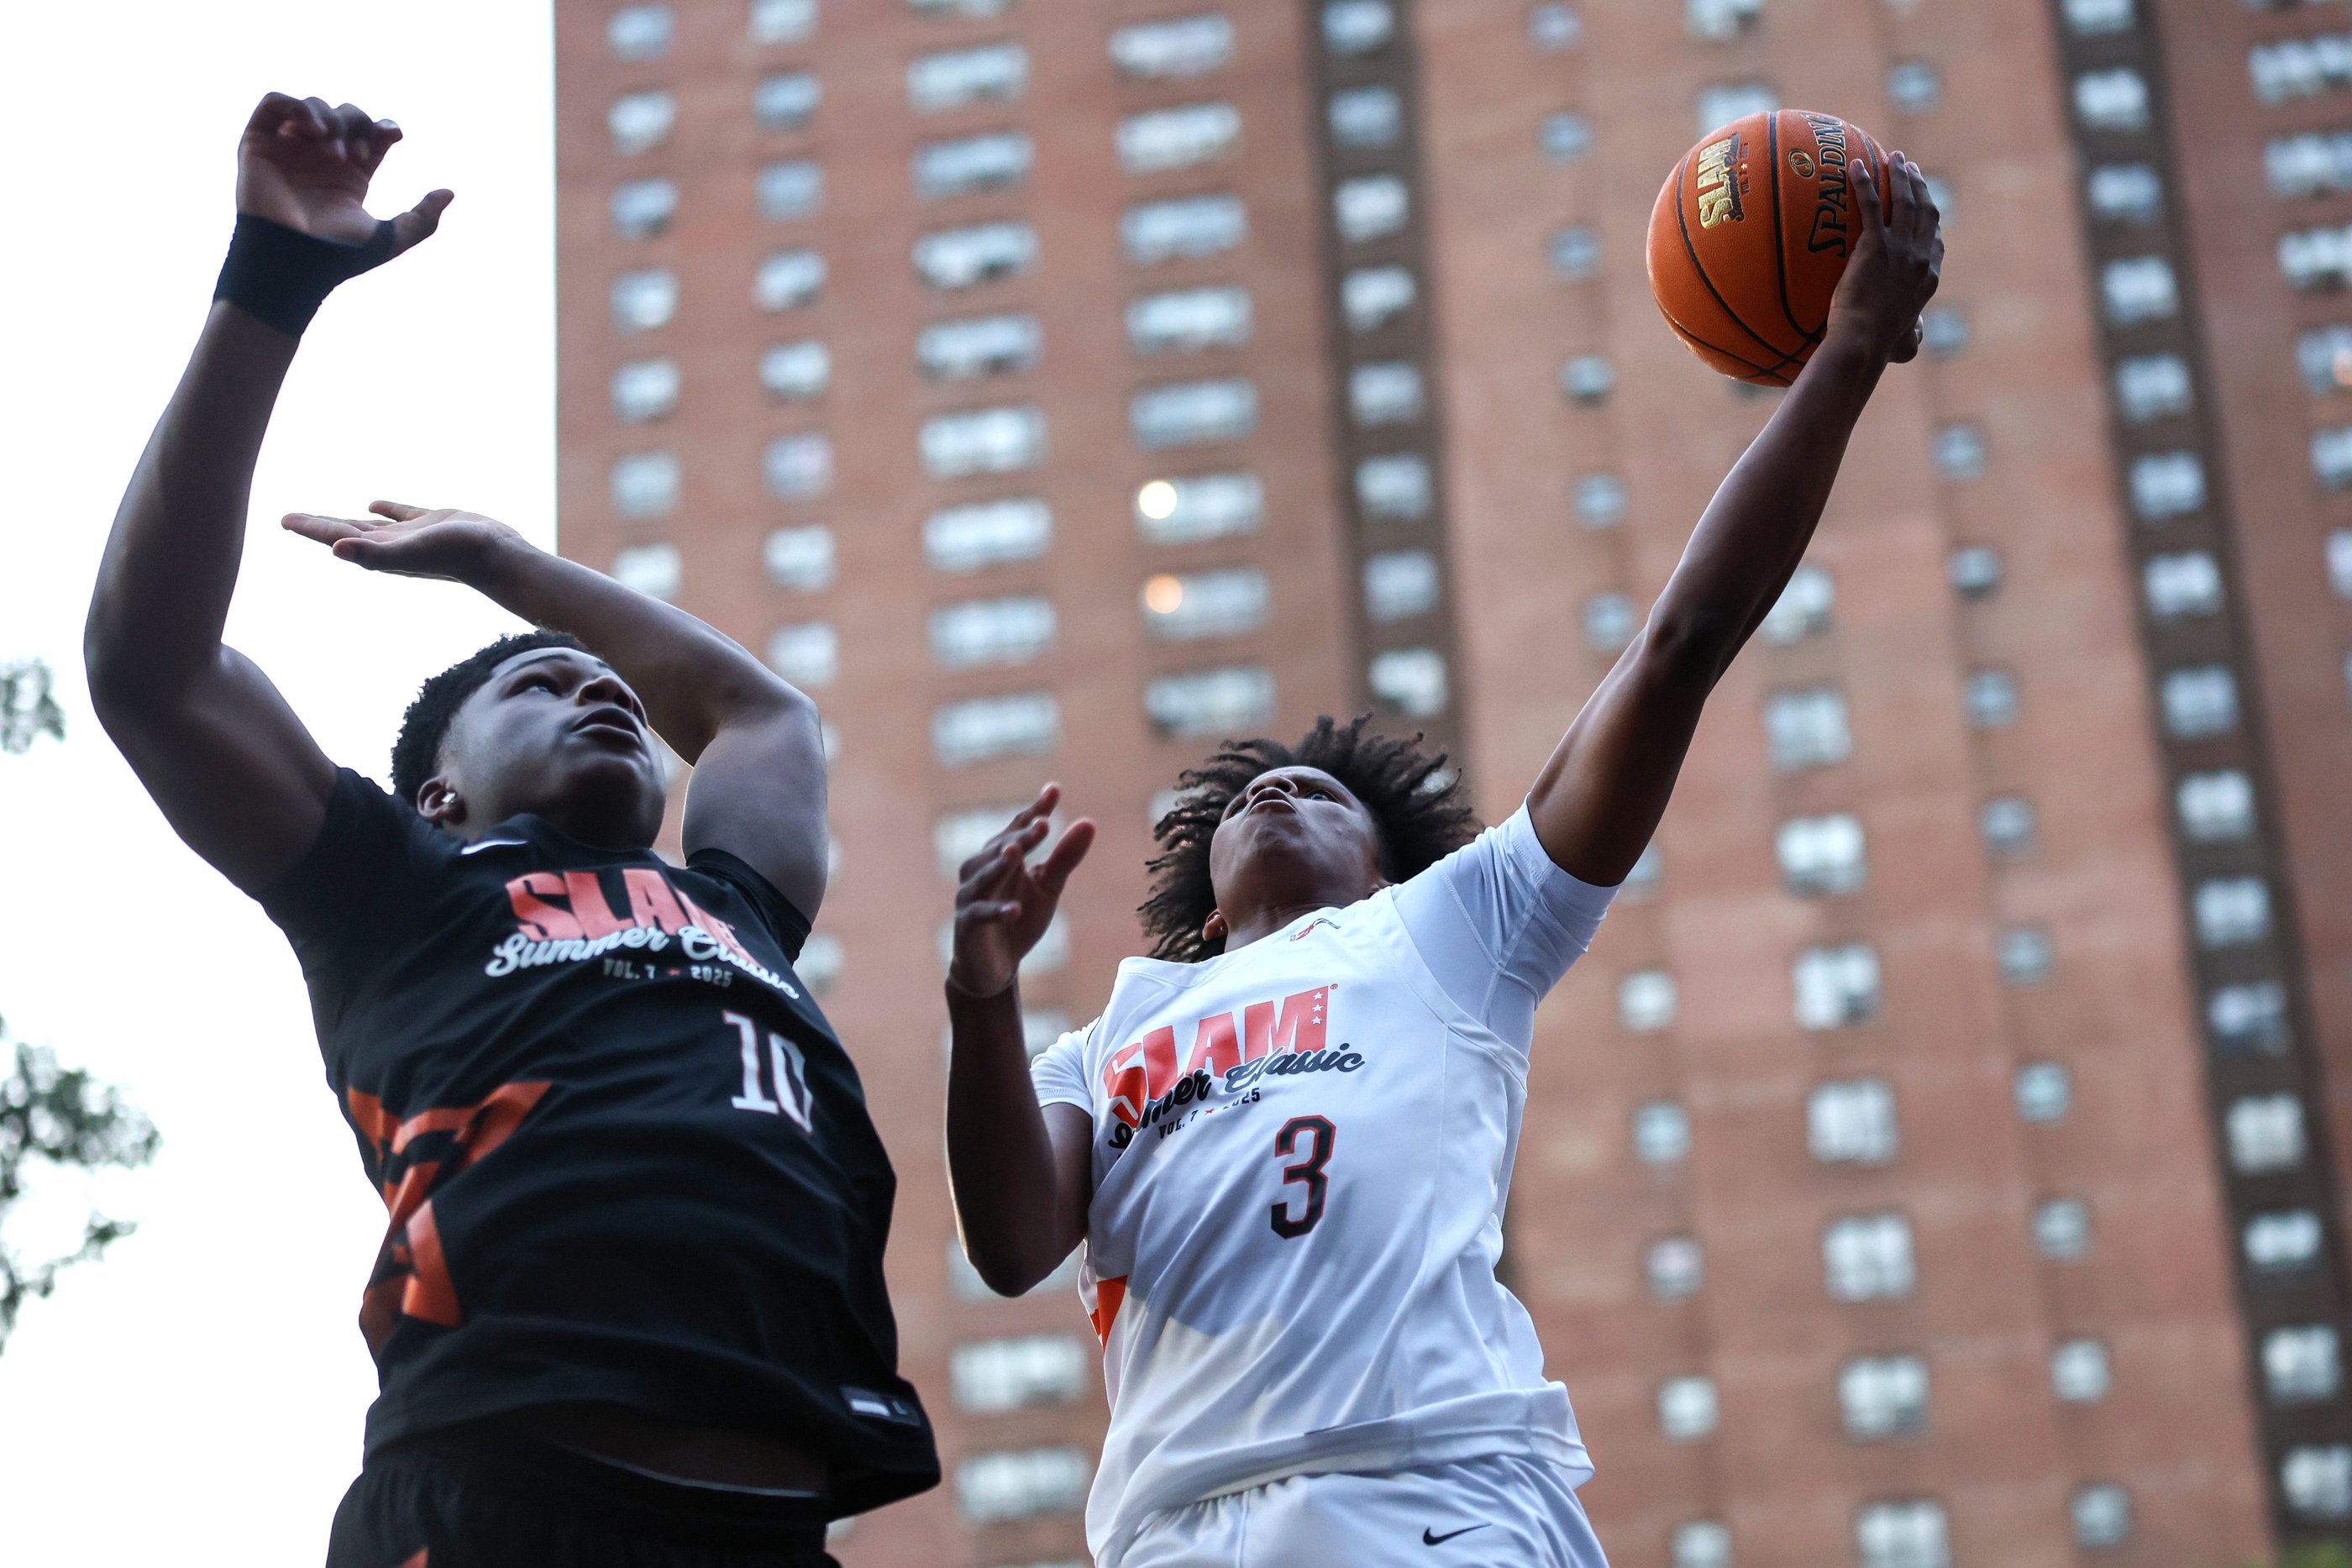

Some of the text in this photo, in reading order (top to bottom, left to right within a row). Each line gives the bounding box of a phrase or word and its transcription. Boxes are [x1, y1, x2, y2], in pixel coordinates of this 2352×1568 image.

[1697, 138, 1734, 229] SLAM
[485, 926, 669, 977] Summer
[722, 1009, 814, 1135] 10
[1103, 985, 1329, 1128] SLAM
[1225, 1042, 1366, 1093] Classic
[1158, 1118, 1185, 1140] VOL.
[1190, 1109, 1199, 1122] 7
[1270, 1114, 1336, 1240] 3
